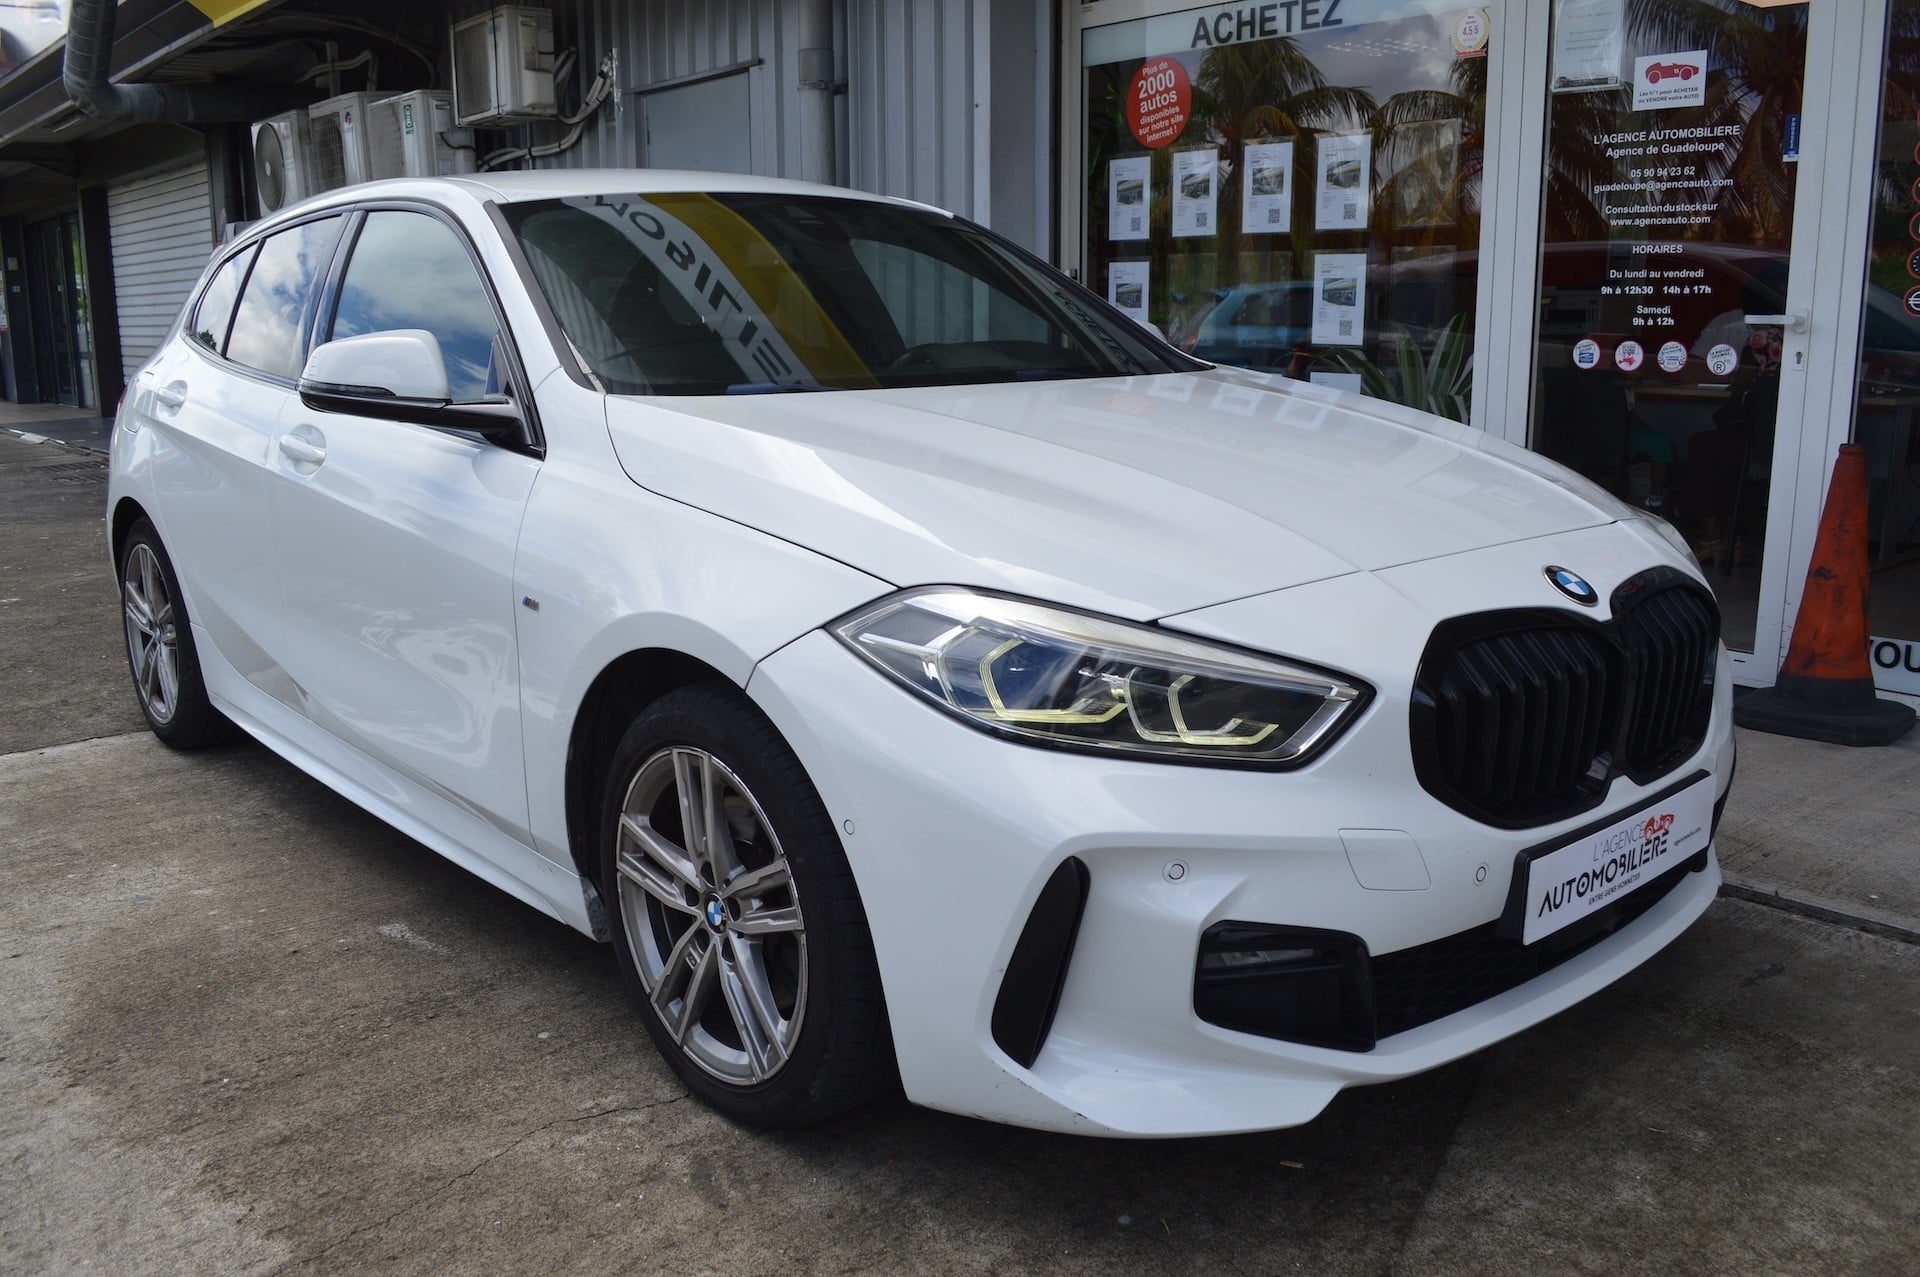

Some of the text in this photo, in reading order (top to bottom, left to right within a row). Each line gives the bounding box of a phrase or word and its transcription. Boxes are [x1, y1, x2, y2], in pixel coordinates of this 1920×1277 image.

[1191, 0, 1343, 48] ACHETEZ
[1142, 61, 1168, 76] Plus de
[1138, 69, 1175, 99] 2000
[1140, 90, 1178, 113] autos
[1140, 105, 1180, 125] disponibles
[1139, 114, 1184, 136] sur notre site
[1146, 126, 1174, 143] internet
[1594, 125, 1741, 145] L'AGENCE AUTOMOBILIERE
[1605, 141, 1725, 159] Agence de Guadeloupe
[1630, 166, 1696, 178] 05 90 94 23 62
[1594, 178, 1734, 194] guadeloupe@agenceauto.com
[1610, 216, 1711, 227] www.agenceauto.com
[1632, 244, 1683, 254] HORAIRES
[1610, 270, 1622, 278] Du
[1624, 270, 1647, 278] lundi
[1663, 269, 1704, 278] vendredi
[1600, 285, 1712, 294] 9h à 12h30 14h à 17h
[1636, 305, 1671, 314] Samedi
[1632, 317, 1674, 326] 9h à 12h
[1593, 820, 1646, 862] L'AGENCE
[1588, 889, 1604, 905] ENTRE
[1604, 884, 1617, 898] GENS
